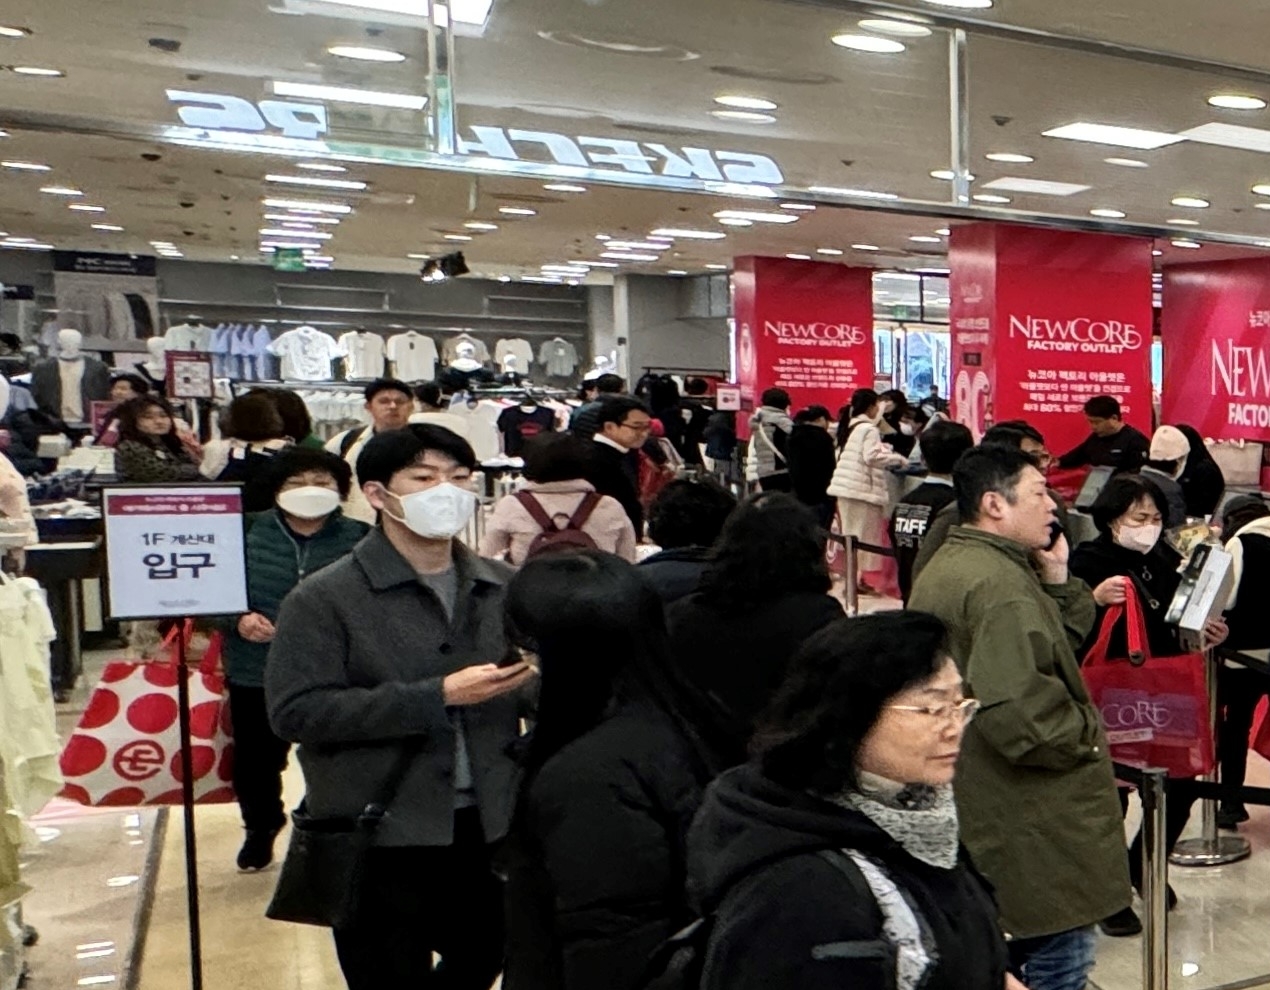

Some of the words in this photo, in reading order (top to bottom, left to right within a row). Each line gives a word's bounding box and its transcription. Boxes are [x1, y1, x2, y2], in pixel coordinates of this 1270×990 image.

[1009, 314, 1142, 350] NEWCORE
[1027, 340, 1079, 353] FACTORY
[1080, 342, 1125, 354] OUTLET
[141, 533, 165, 546] 1F
[143, 552, 216, 580] 입구
[1101, 701, 1171, 728] CORE
